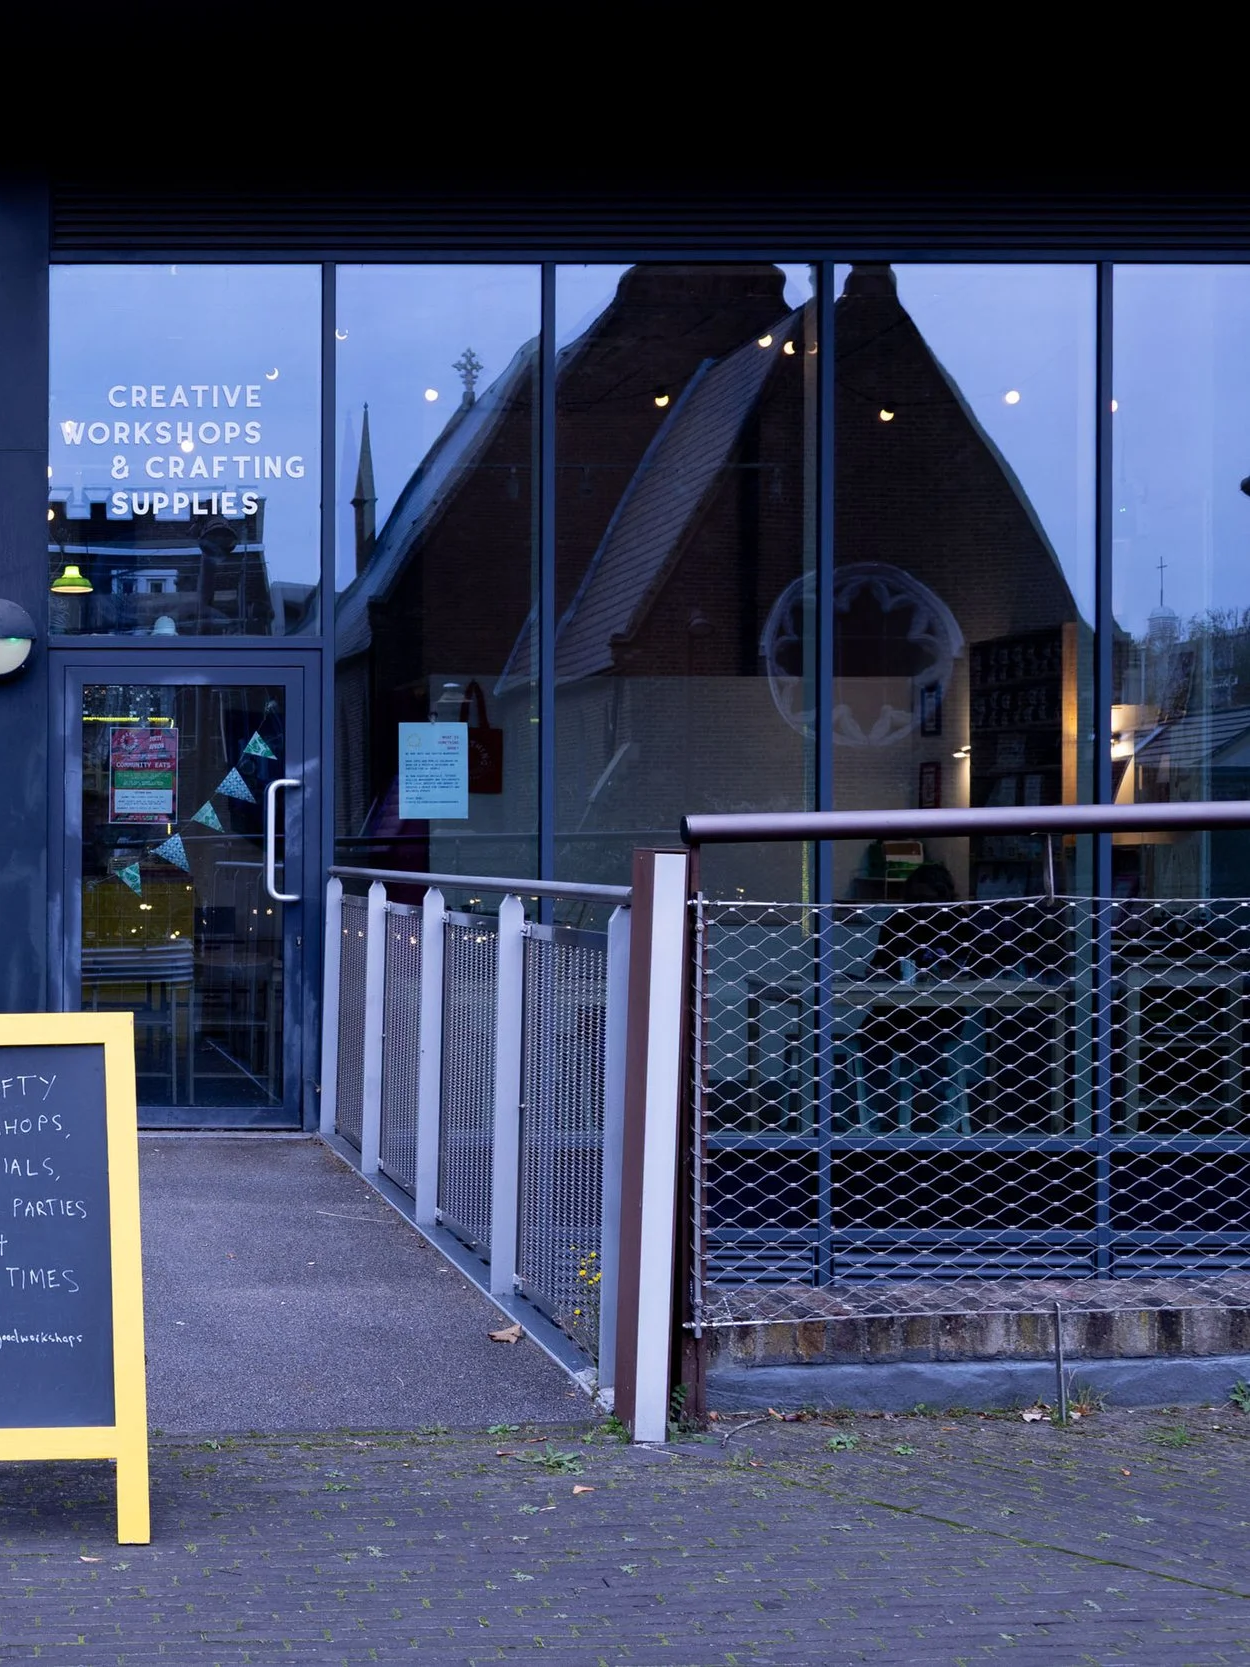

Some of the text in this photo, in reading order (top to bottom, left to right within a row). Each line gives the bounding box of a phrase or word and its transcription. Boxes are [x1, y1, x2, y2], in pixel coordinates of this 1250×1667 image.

[108, 384, 262, 408] CREATIVE
[60, 420, 261, 446] WORKSHOPS
[111, 455, 305, 480] & CRAFTING
[111, 491, 259, 516] SUPPLIES
[116, 761, 171, 769] COMMUNITY EATS
[13, 1198, 87, 1219] PARTIES
[6, 1266, 80, 1293] TIMES
